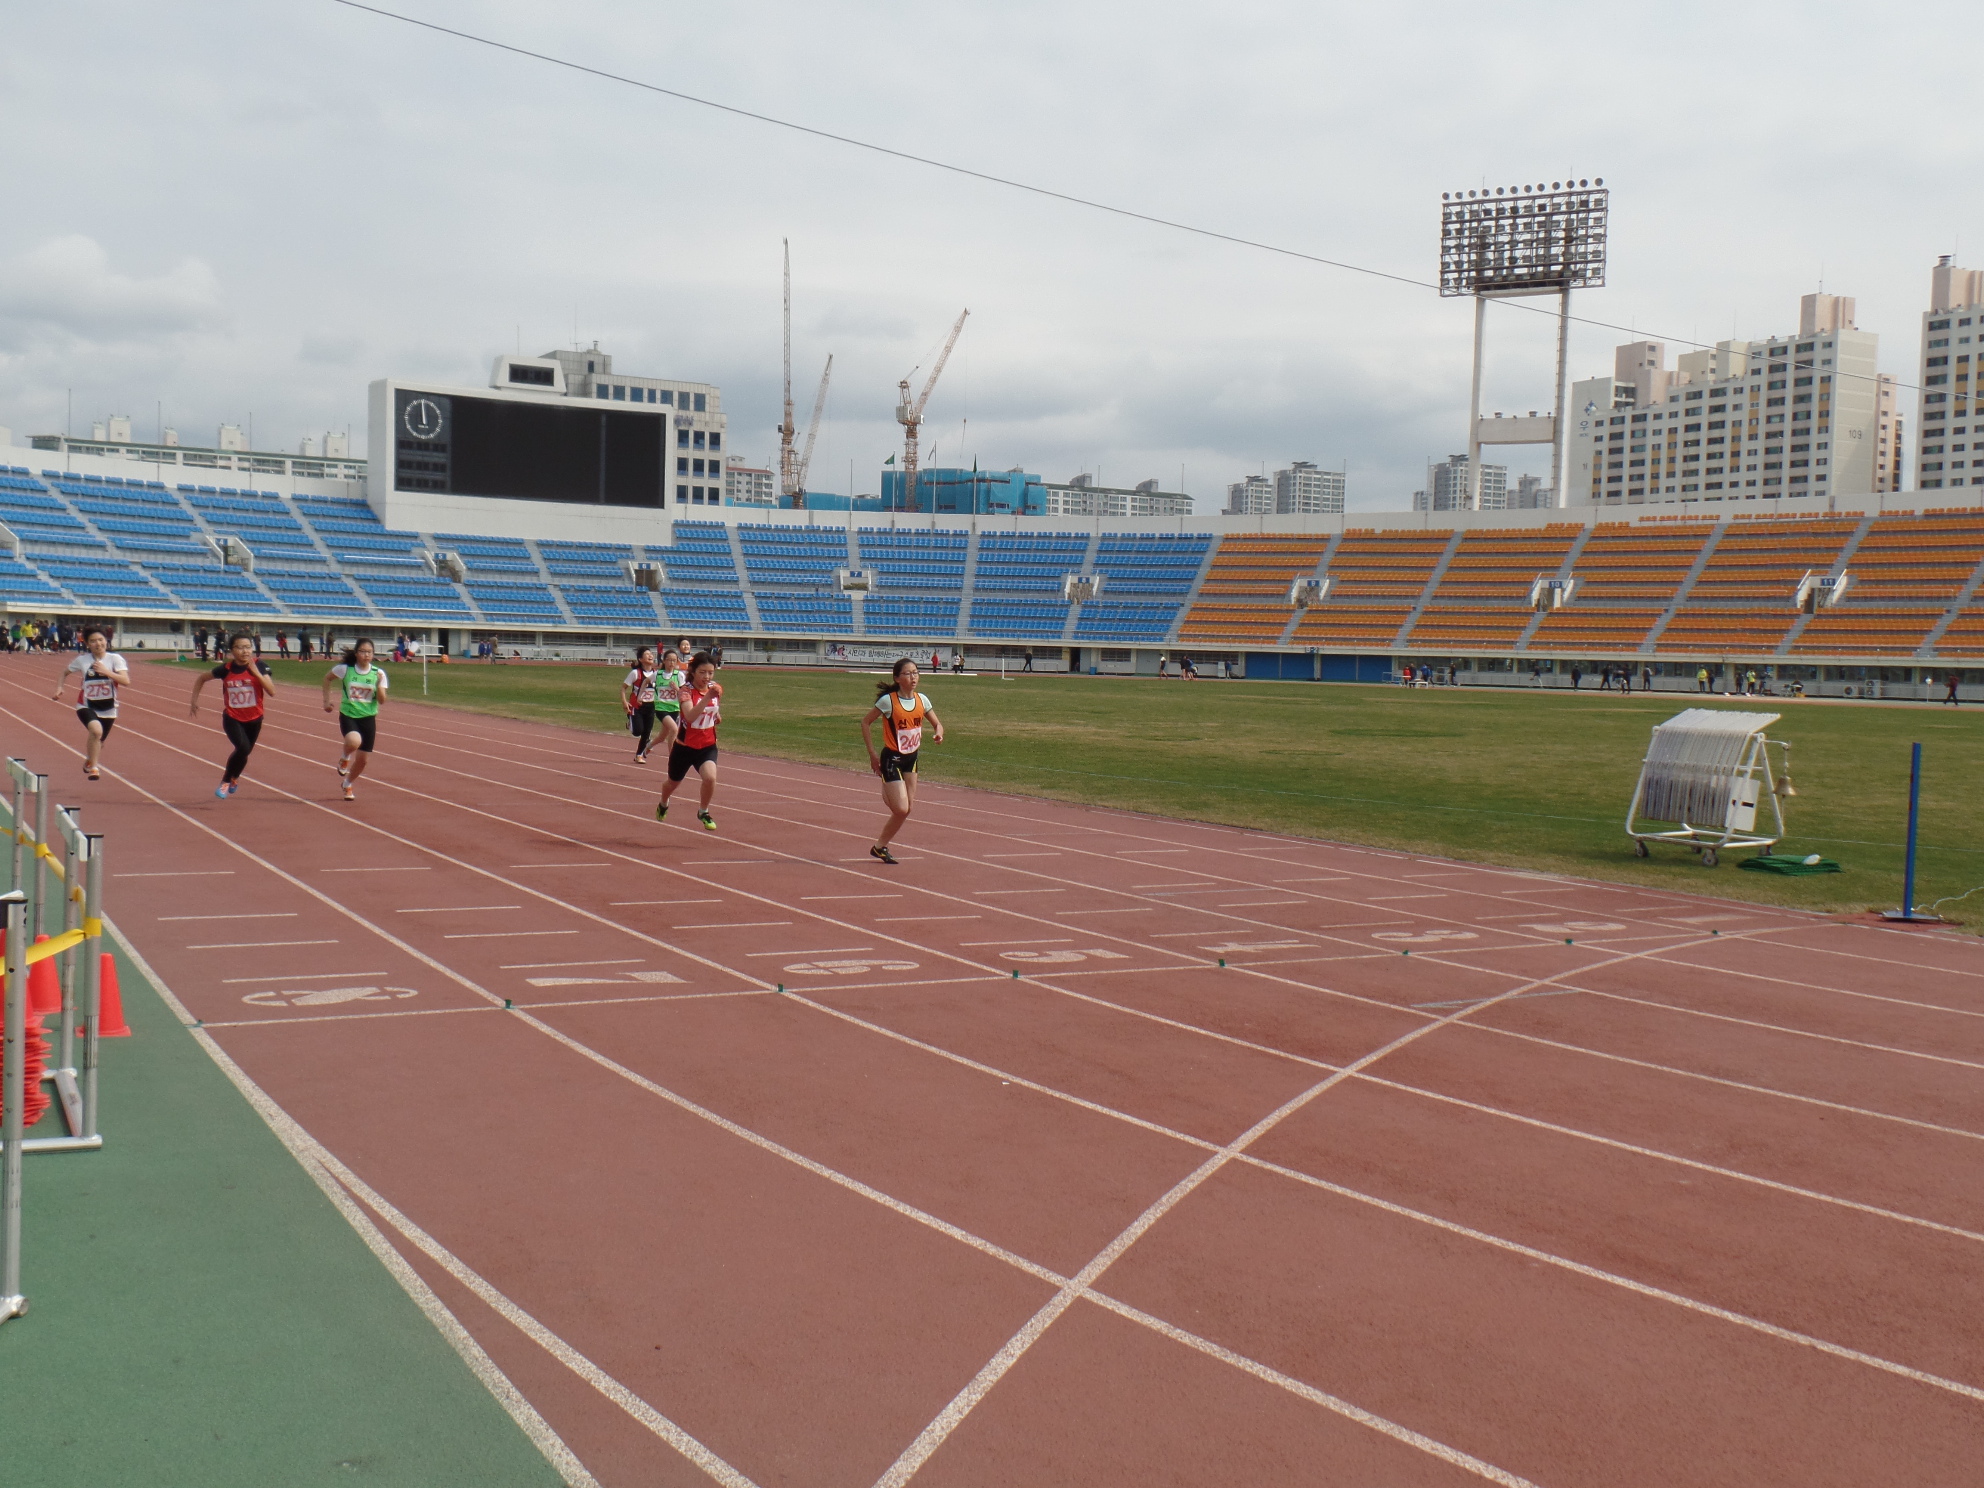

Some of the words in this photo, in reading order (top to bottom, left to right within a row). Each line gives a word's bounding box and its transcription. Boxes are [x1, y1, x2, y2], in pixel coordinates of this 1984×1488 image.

[1849, 429, 1862, 440] 109
[86, 683, 111, 697] 275
[659, 689, 677, 700] 228
[230, 690, 253, 705] 207
[899, 732, 921, 751] 240
